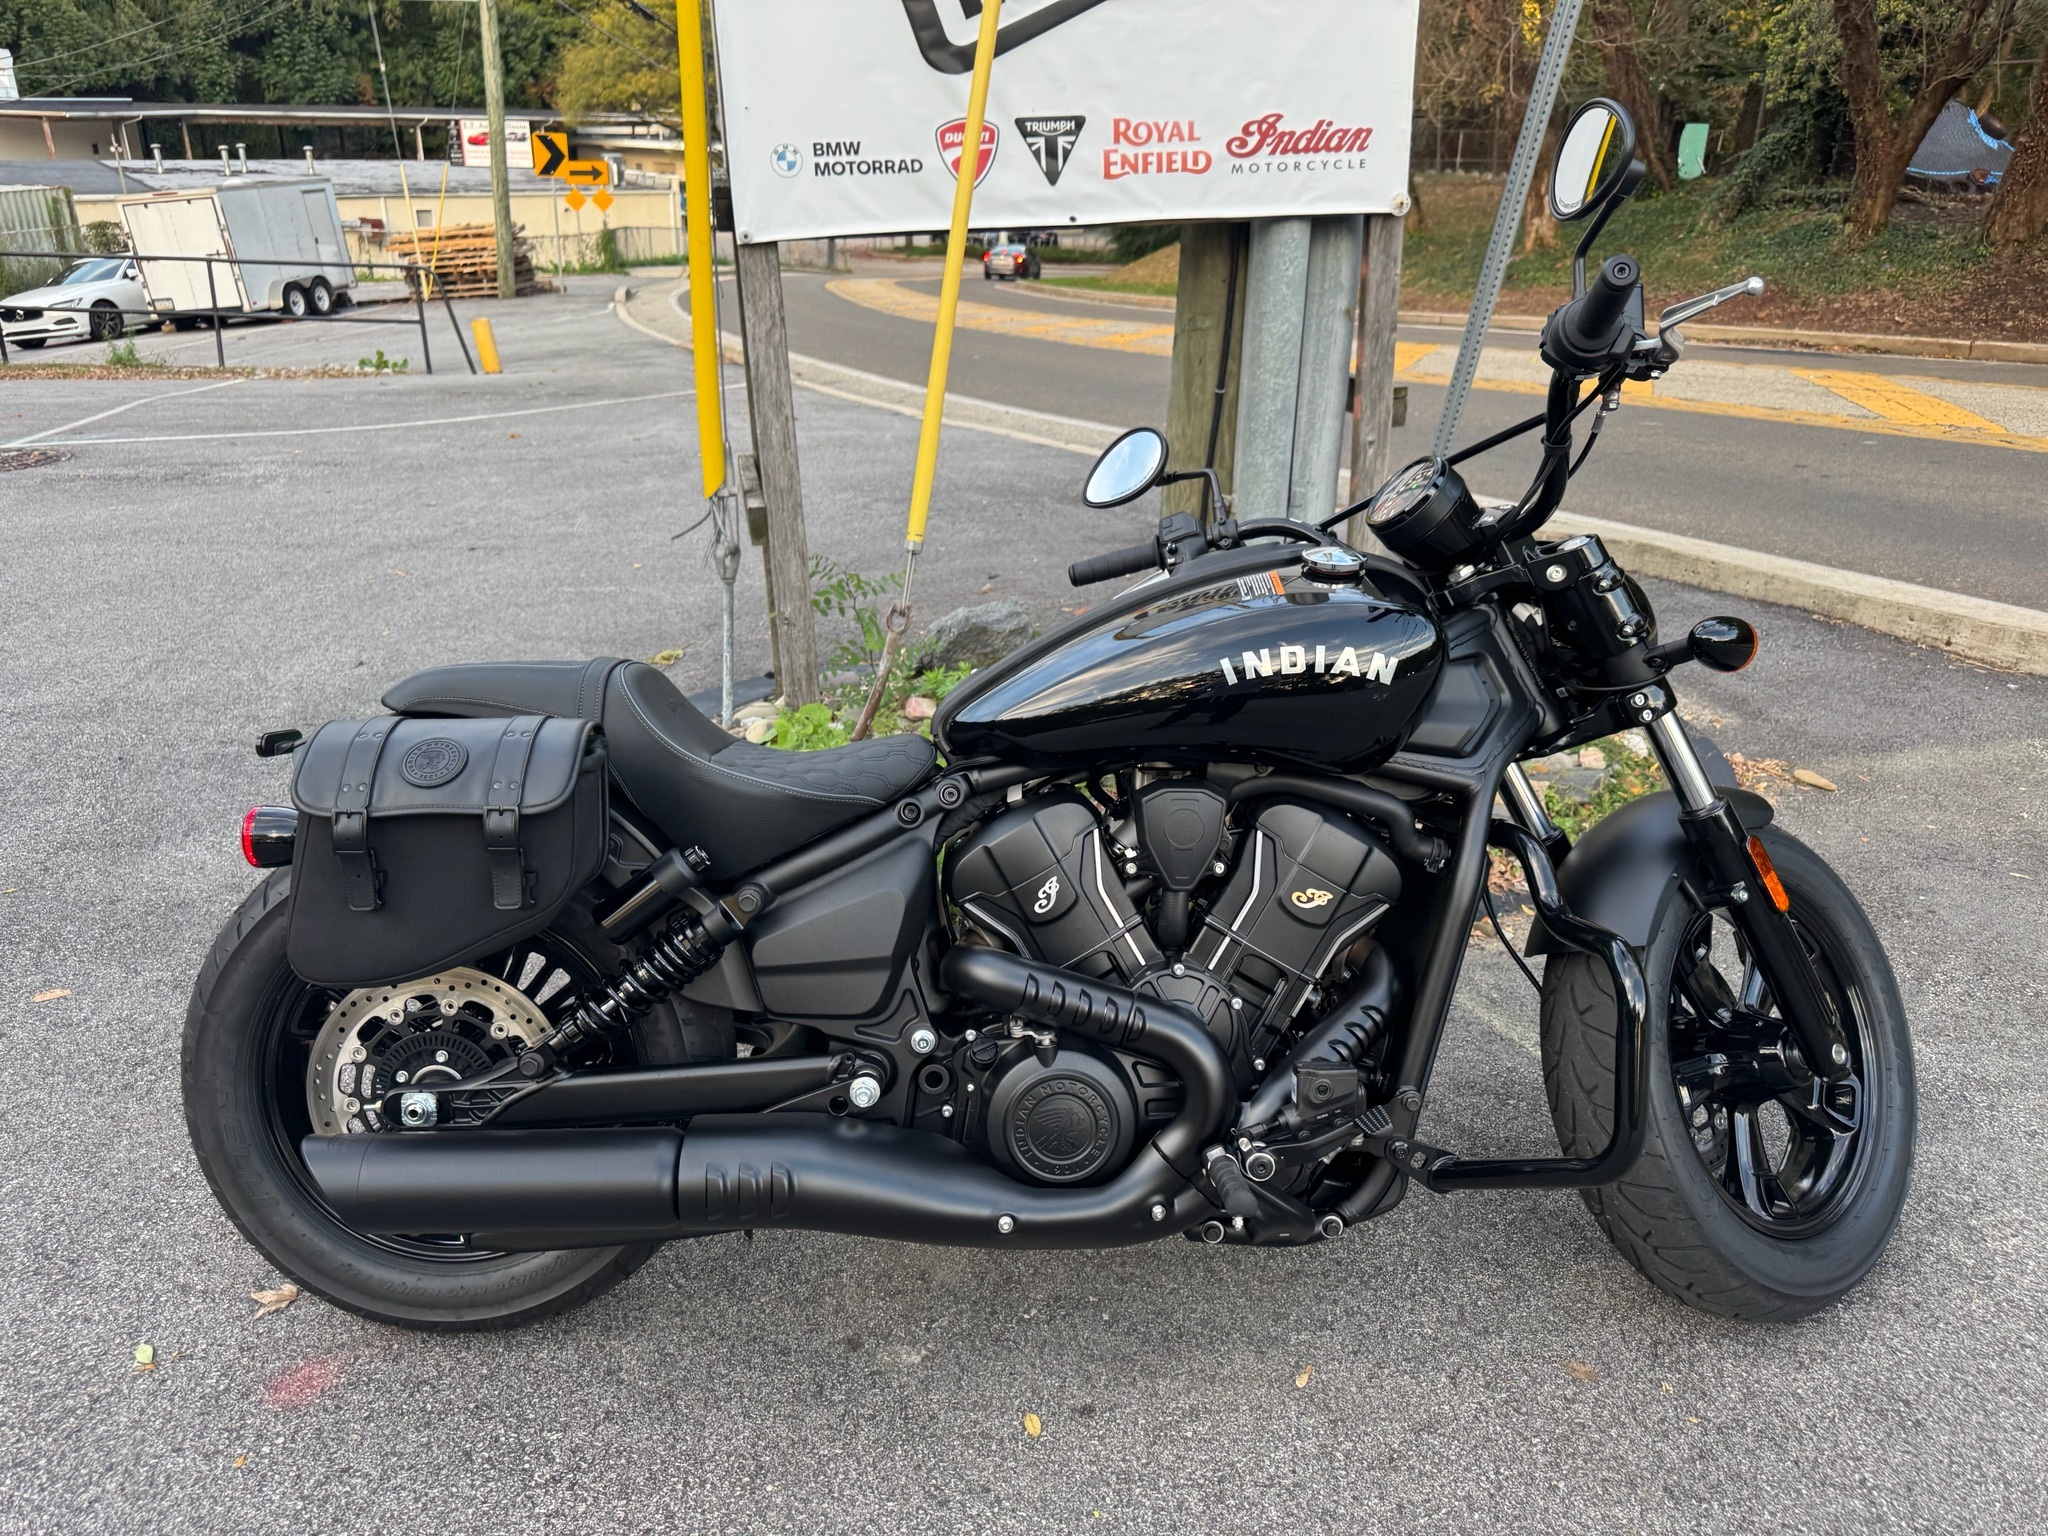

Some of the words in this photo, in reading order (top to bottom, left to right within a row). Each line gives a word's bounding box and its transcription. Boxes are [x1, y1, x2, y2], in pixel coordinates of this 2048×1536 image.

[944, 131, 990, 144] DUTI
[1024, 119, 1076, 133] TRIUMPH
[1112, 117, 1201, 147] ROYAL
[1225, 113, 1374, 159] Indian
[813, 141, 861, 157] BMW
[814, 158, 923, 177] MOTORRAD
[1103, 148, 1213, 180] ENFIELD
[1231, 158, 1367, 175] MOTORCYCLE
[1219, 644, 1399, 686] INDIAN
[1015, 1094, 1037, 1158] INDIAN
[1040, 1081, 1109, 1157] MOTORCYCLE
